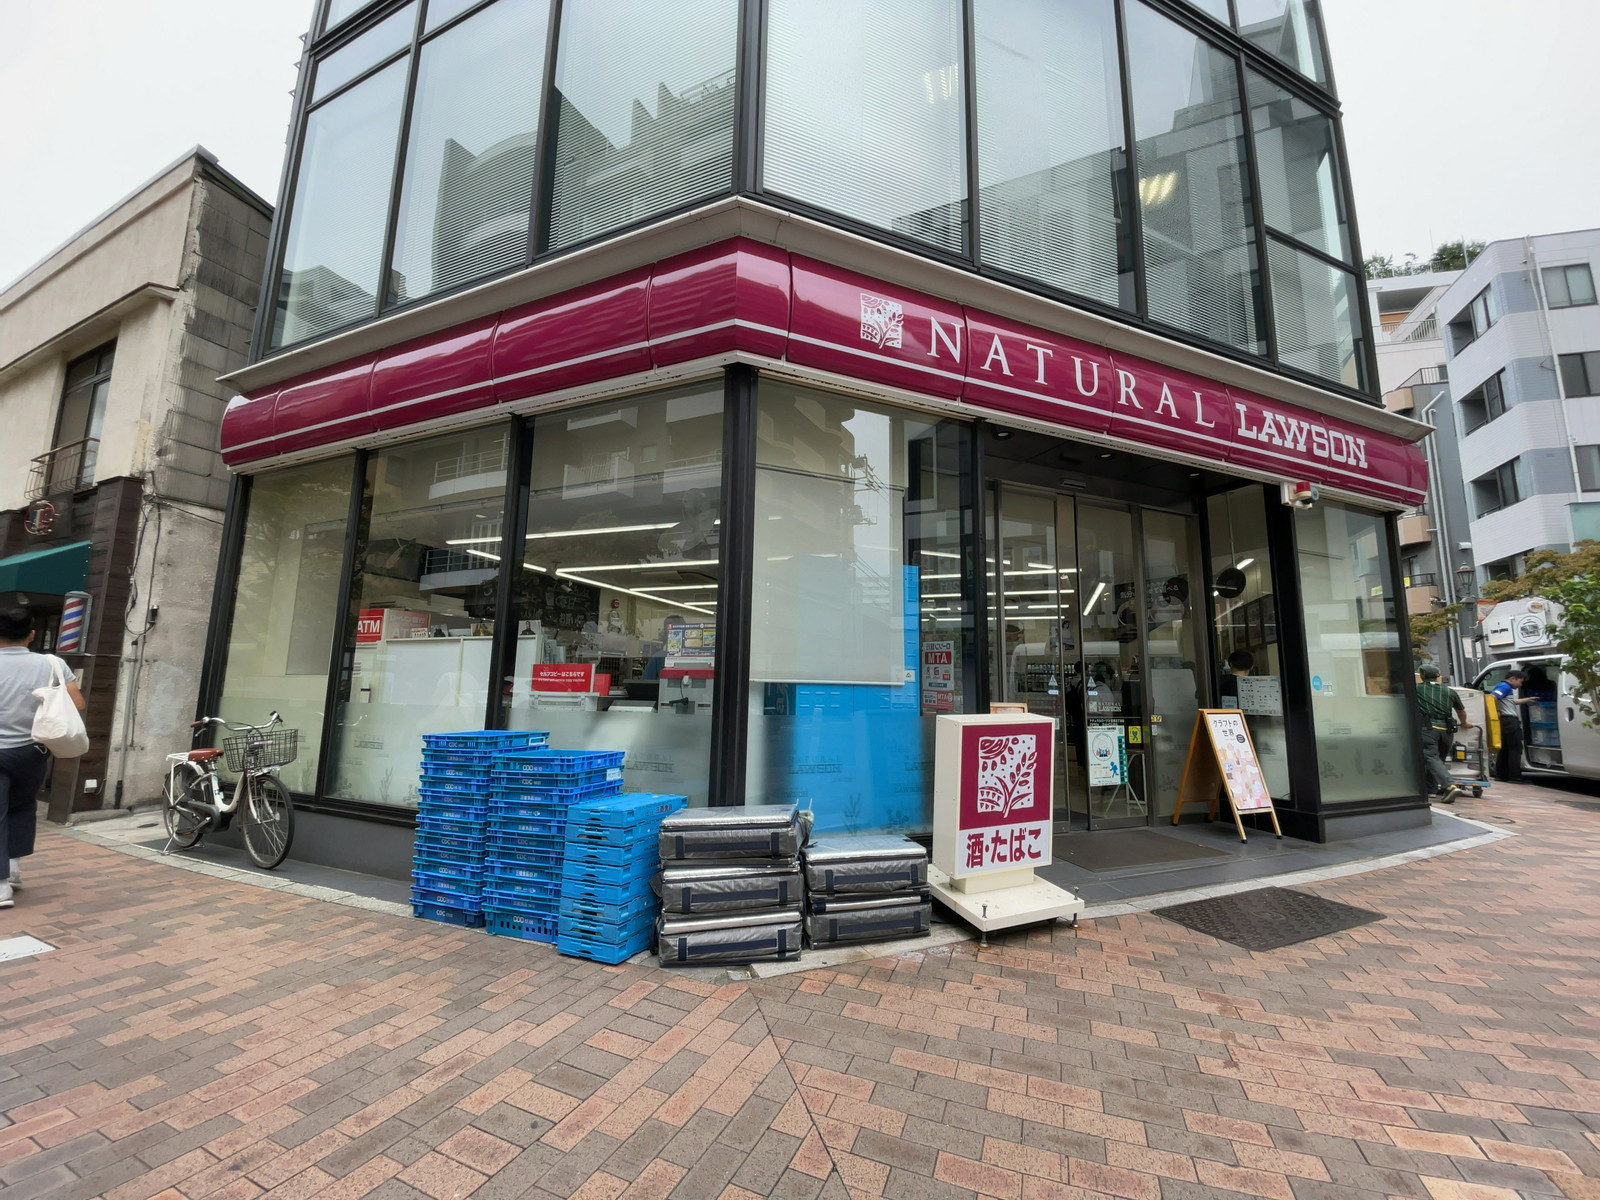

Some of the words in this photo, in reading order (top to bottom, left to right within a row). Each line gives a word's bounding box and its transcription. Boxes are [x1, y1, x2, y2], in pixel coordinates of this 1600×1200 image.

[926, 315, 1215, 428] NATURAL
[1235, 402, 1368, 468] LAWSON
[357, 619, 381, 633] ATM
[1213, 719, 1239, 728] クラフトの
[1222, 729, 1235, 737] 世界
[965, 827, 1042, 869] 酒・たばこ
